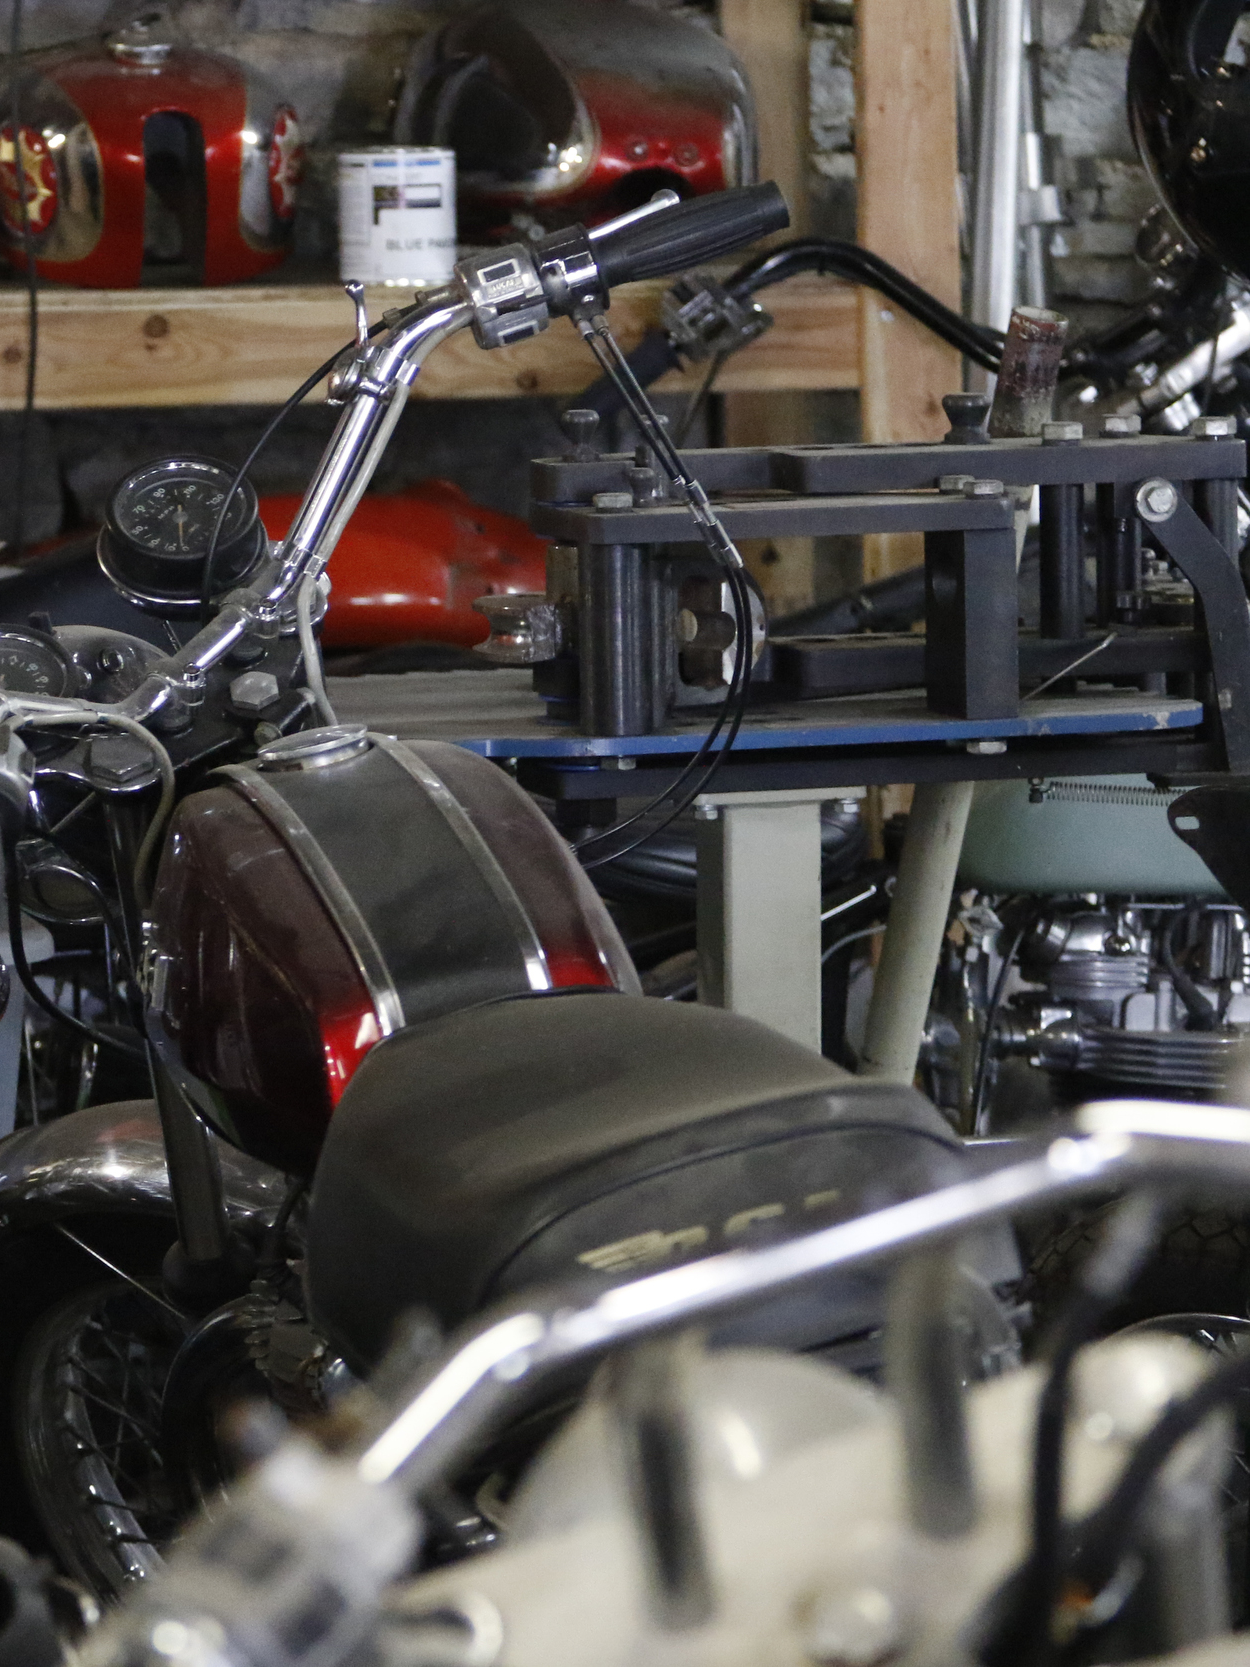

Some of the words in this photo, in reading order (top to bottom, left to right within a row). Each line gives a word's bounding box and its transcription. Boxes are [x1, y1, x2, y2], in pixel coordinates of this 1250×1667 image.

[386, 238, 422, 250] BLUE
[153, 487, 166, 498] 90
[183, 484, 196, 495] 110
[132, 504, 145, 514] 70
[131, 525, 144, 536] 50
